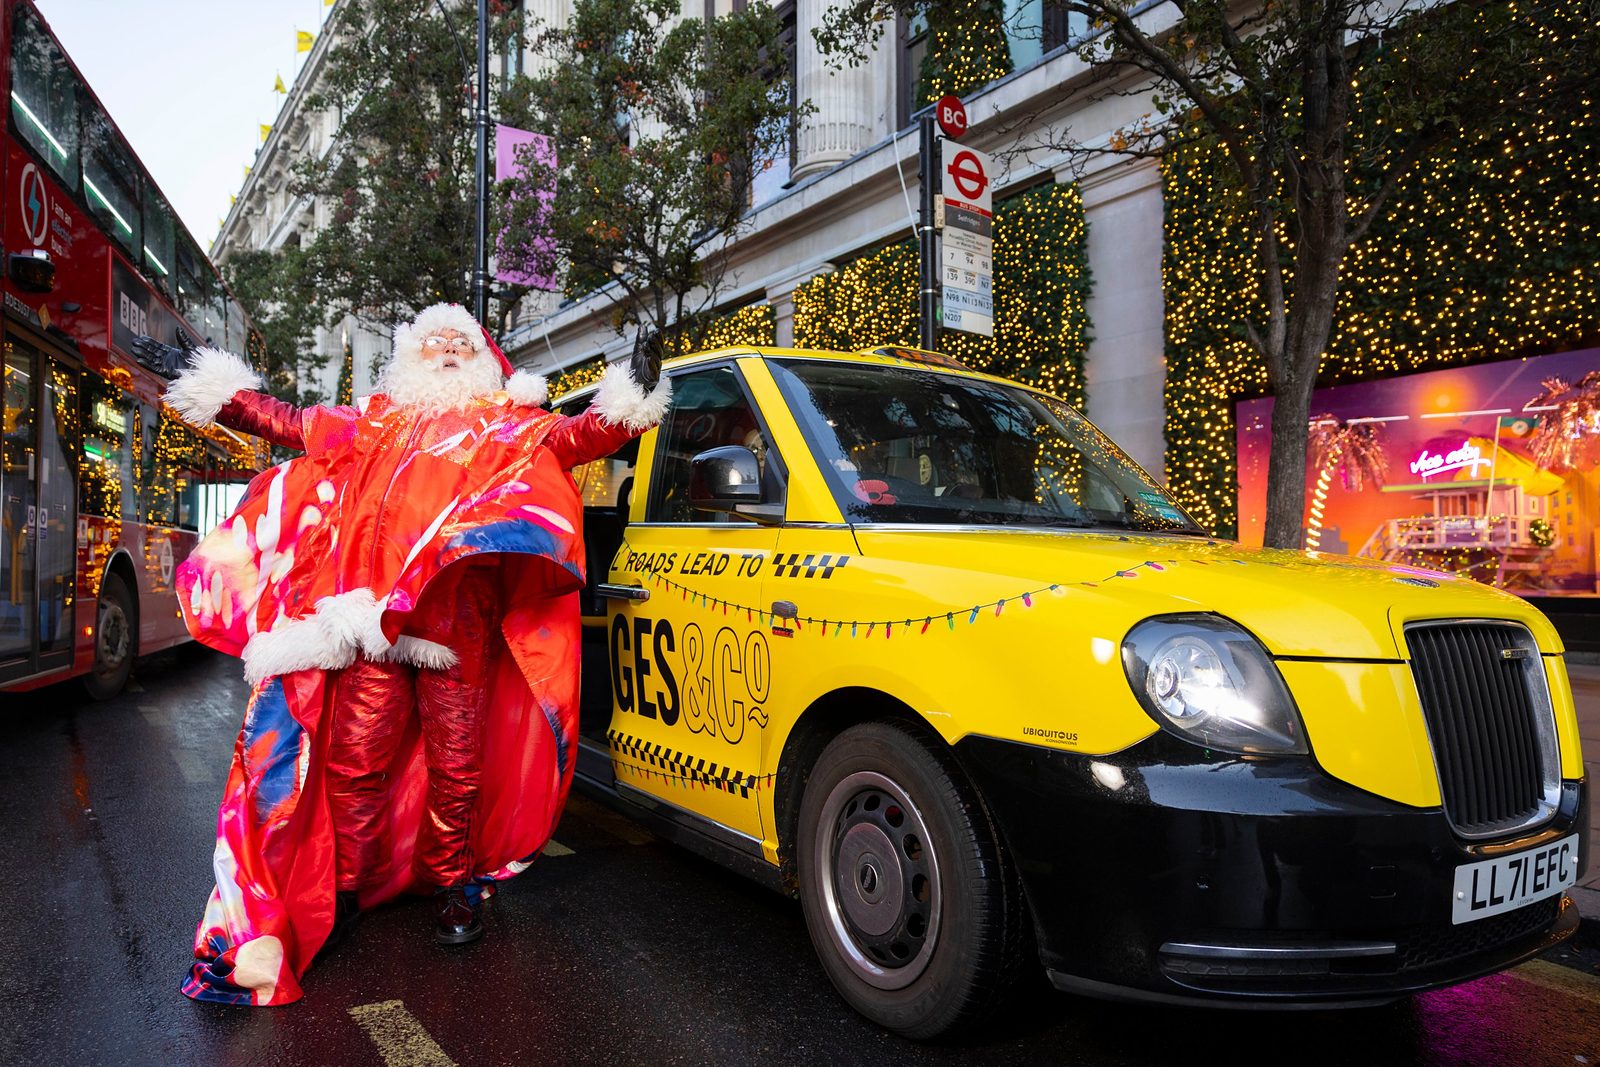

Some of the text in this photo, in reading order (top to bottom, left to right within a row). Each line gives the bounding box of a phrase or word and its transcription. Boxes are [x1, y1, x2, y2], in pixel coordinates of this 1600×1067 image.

[943, 106, 964, 129] BC
[960, 202, 969, 210] BUS
[55, 203, 64, 220] am
[64, 212, 72, 228] an
[950, 252, 954, 260] 7
[966, 256, 974, 265] 94
[981, 260, 989, 270] 98
[947, 272, 959, 281] 139
[965, 276, 976, 286] 390
[981, 281, 989, 289] N7
[946, 292, 993, 311] N98 N113 N137
[945, 312, 962, 323] N207
[1410, 450, 1445, 474] vice
[624, 551, 678, 574] ROADS
[680, 552, 730, 576] LEAD
[737, 553, 765, 578] TO
[1023, 727, 1078, 741] UBIQUITOUS
